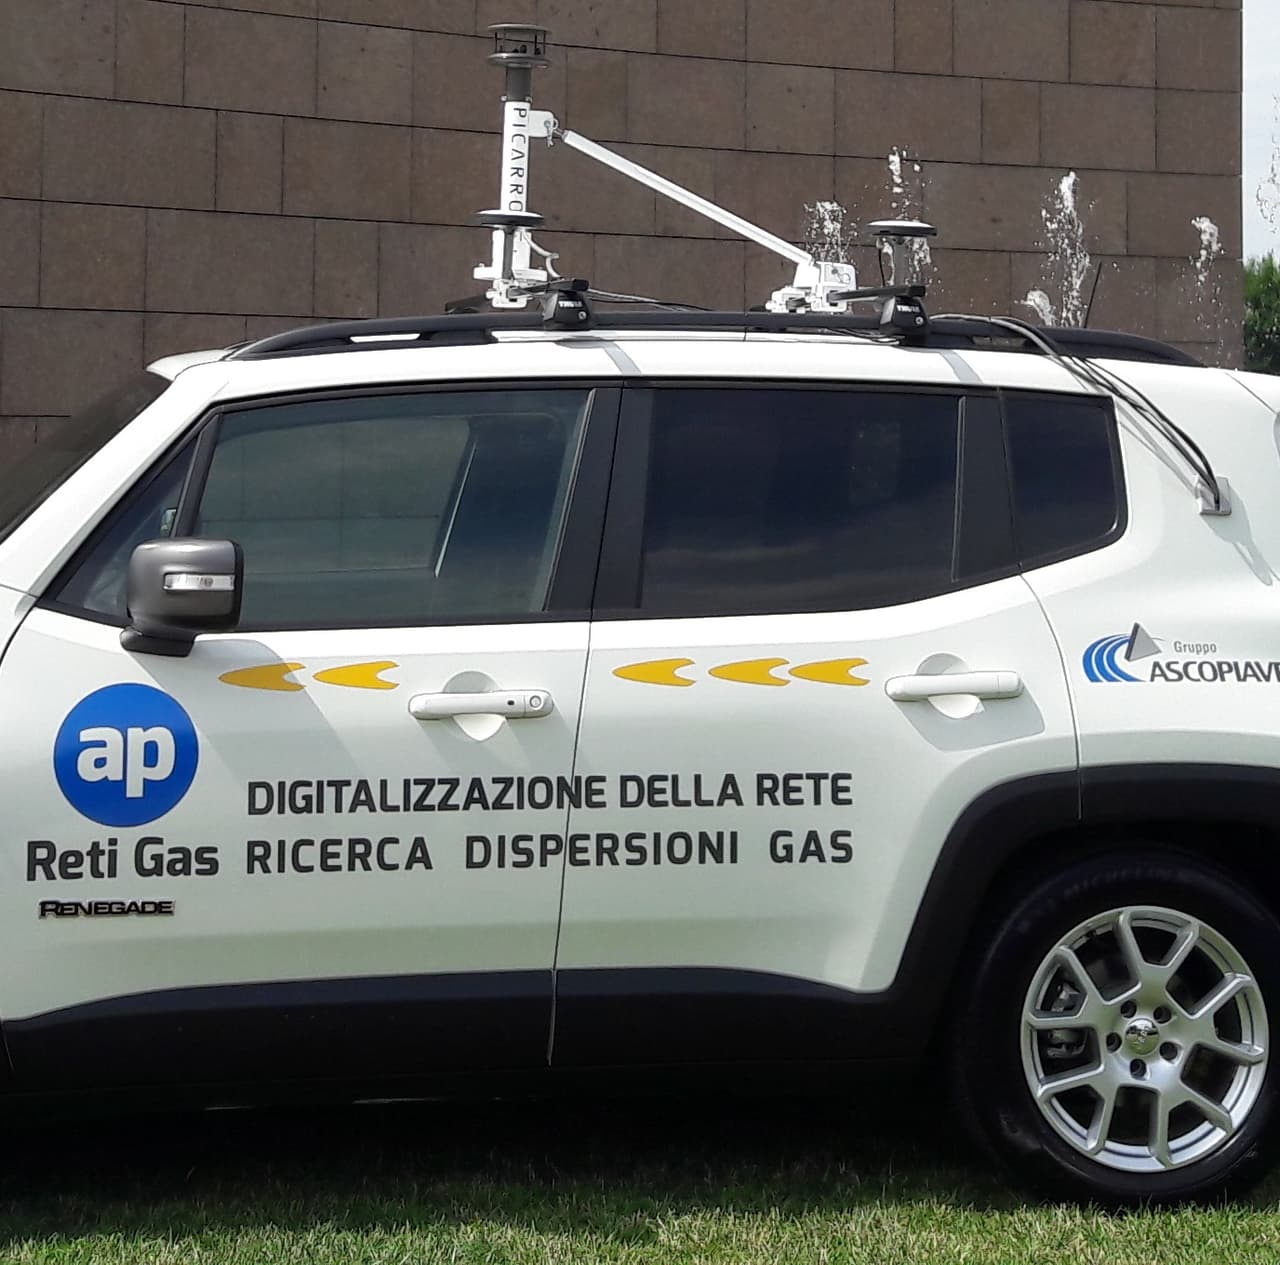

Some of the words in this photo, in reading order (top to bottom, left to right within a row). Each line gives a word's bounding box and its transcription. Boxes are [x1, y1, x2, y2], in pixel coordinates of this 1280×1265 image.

[508, 107, 527, 212] PICARRO
[1173, 641, 1217, 655] Gruppo
[77, 726, 176, 798] ap
[247, 776, 607, 815] DIGITALIZZAZIONE
[619, 773, 744, 808] DELLA
[756, 772, 853, 806] RETE
[26, 838, 118, 881] Reti
[134, 836, 220, 877] Gas
[246, 837, 433, 874] RICERCA
[465, 830, 738, 869] DISPERSIONI
[770, 829, 853, 864] GAS
